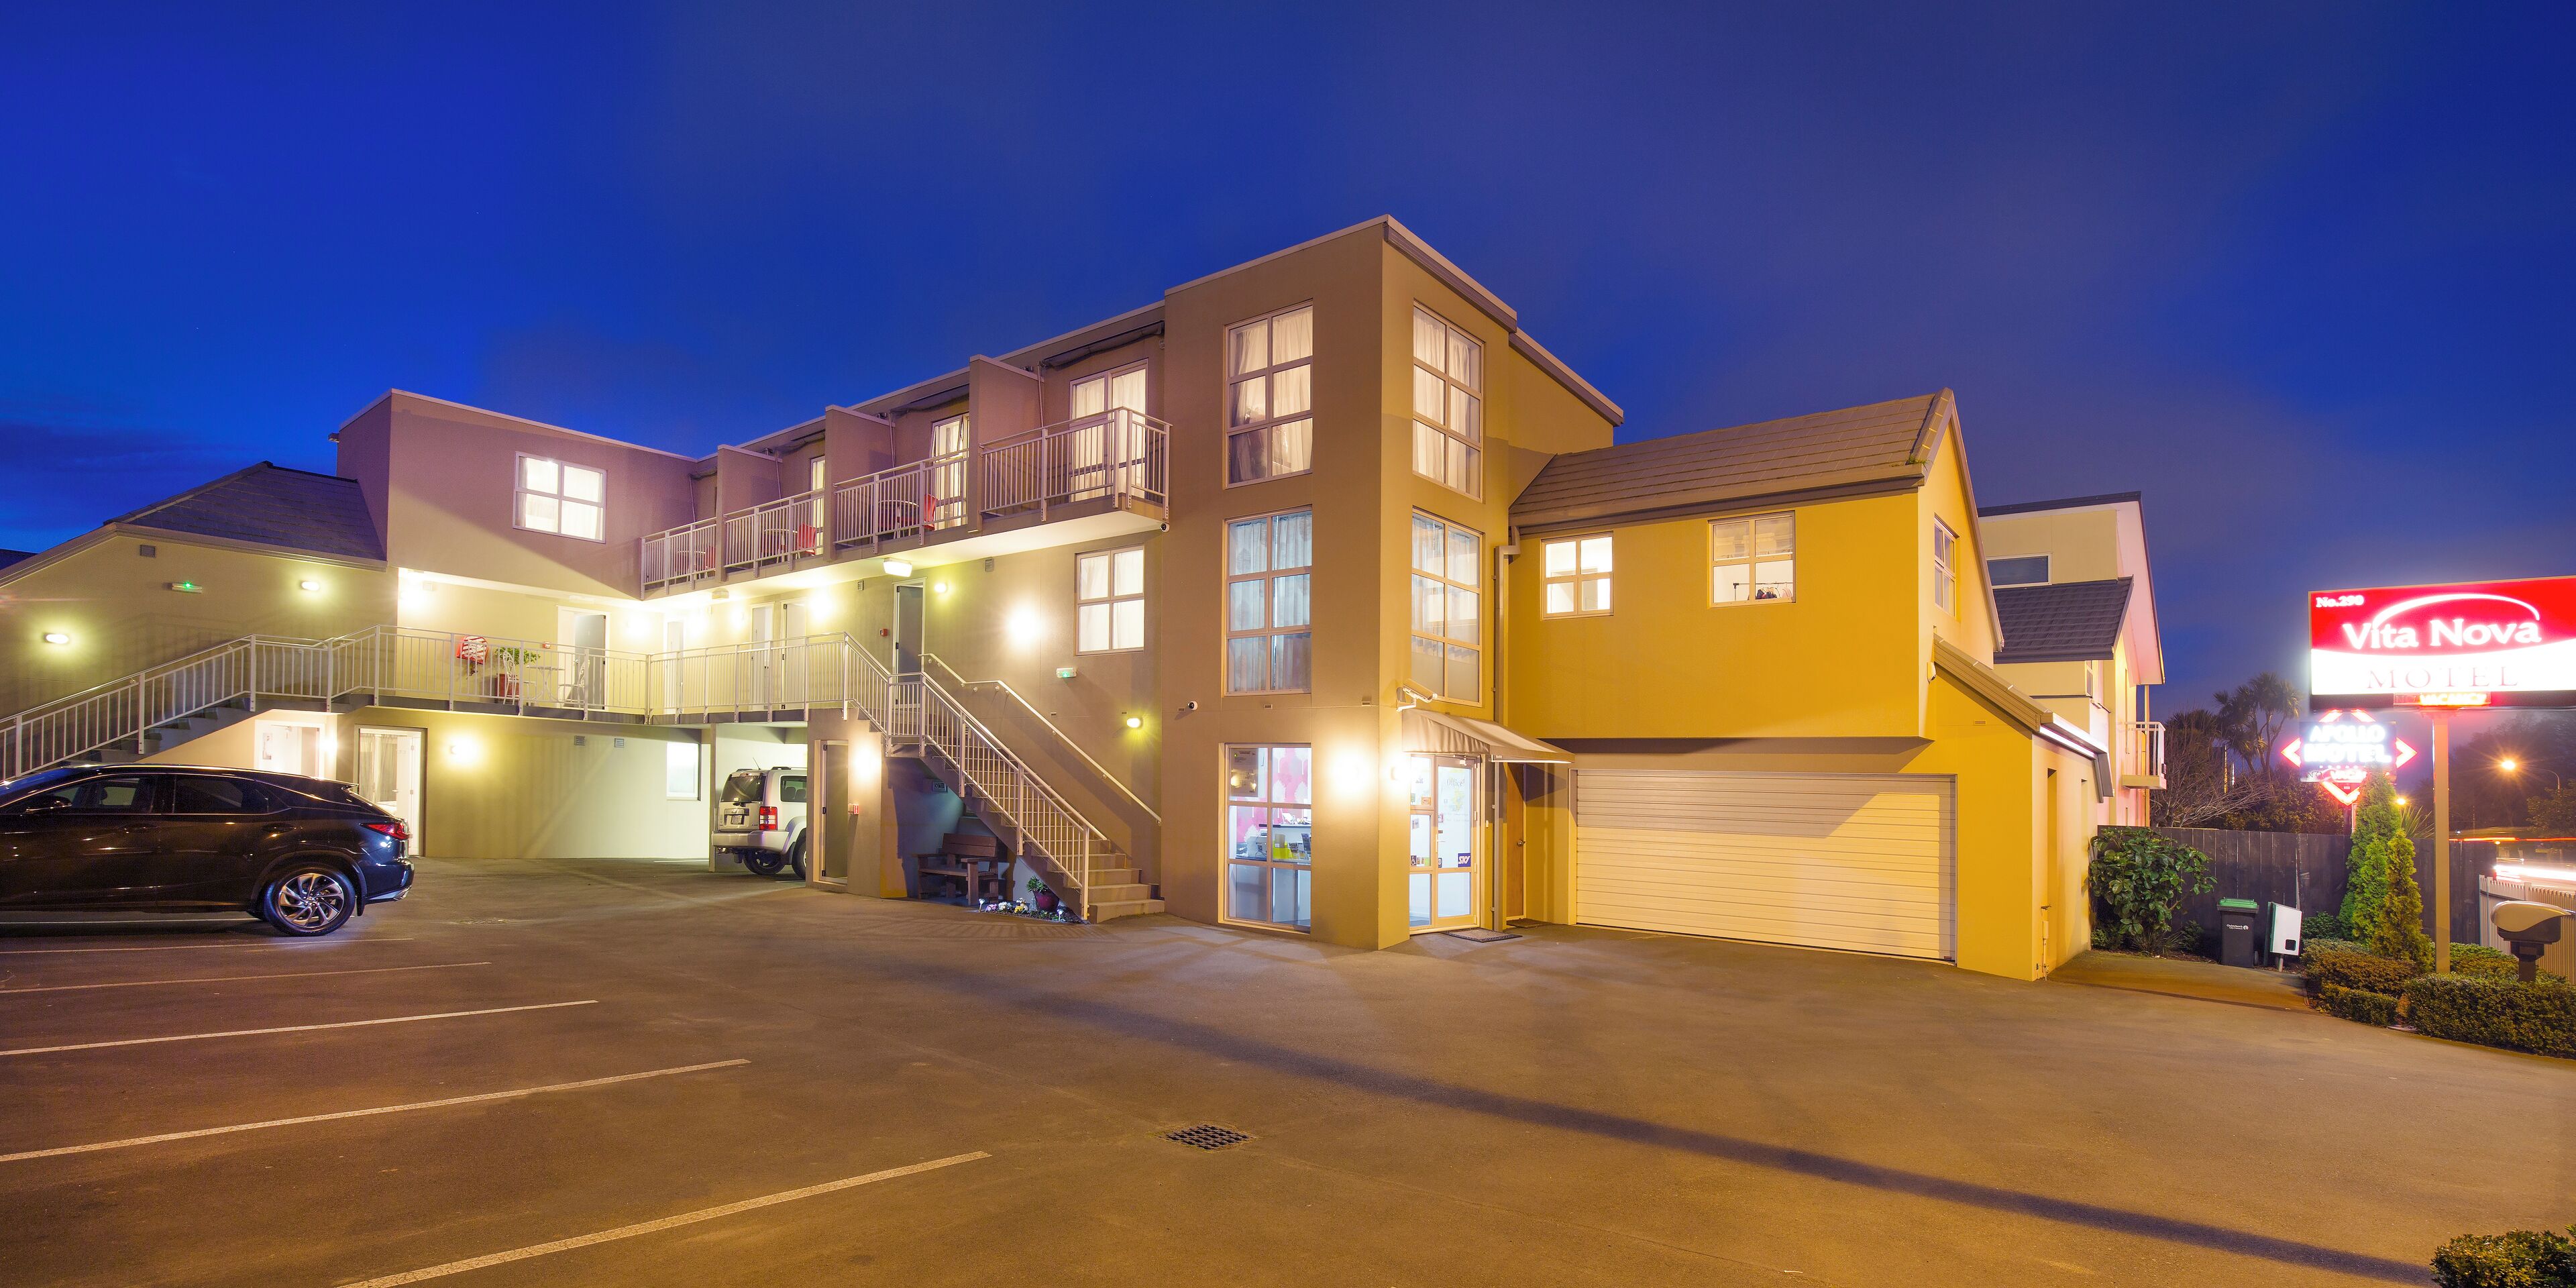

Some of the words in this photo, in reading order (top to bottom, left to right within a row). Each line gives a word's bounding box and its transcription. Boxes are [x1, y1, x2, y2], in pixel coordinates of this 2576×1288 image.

[2342, 623, 2419, 649] Vita
[2429, 618, 2542, 646] Nova
[2367, 666, 2518, 689] MOTEL
[2420, 692, 2487, 705] VACANCY
[2309, 724, 2385, 743] APOLLO
[2304, 743, 2392, 763] MOTEL
[1458, 855, 1470, 864] SKY
